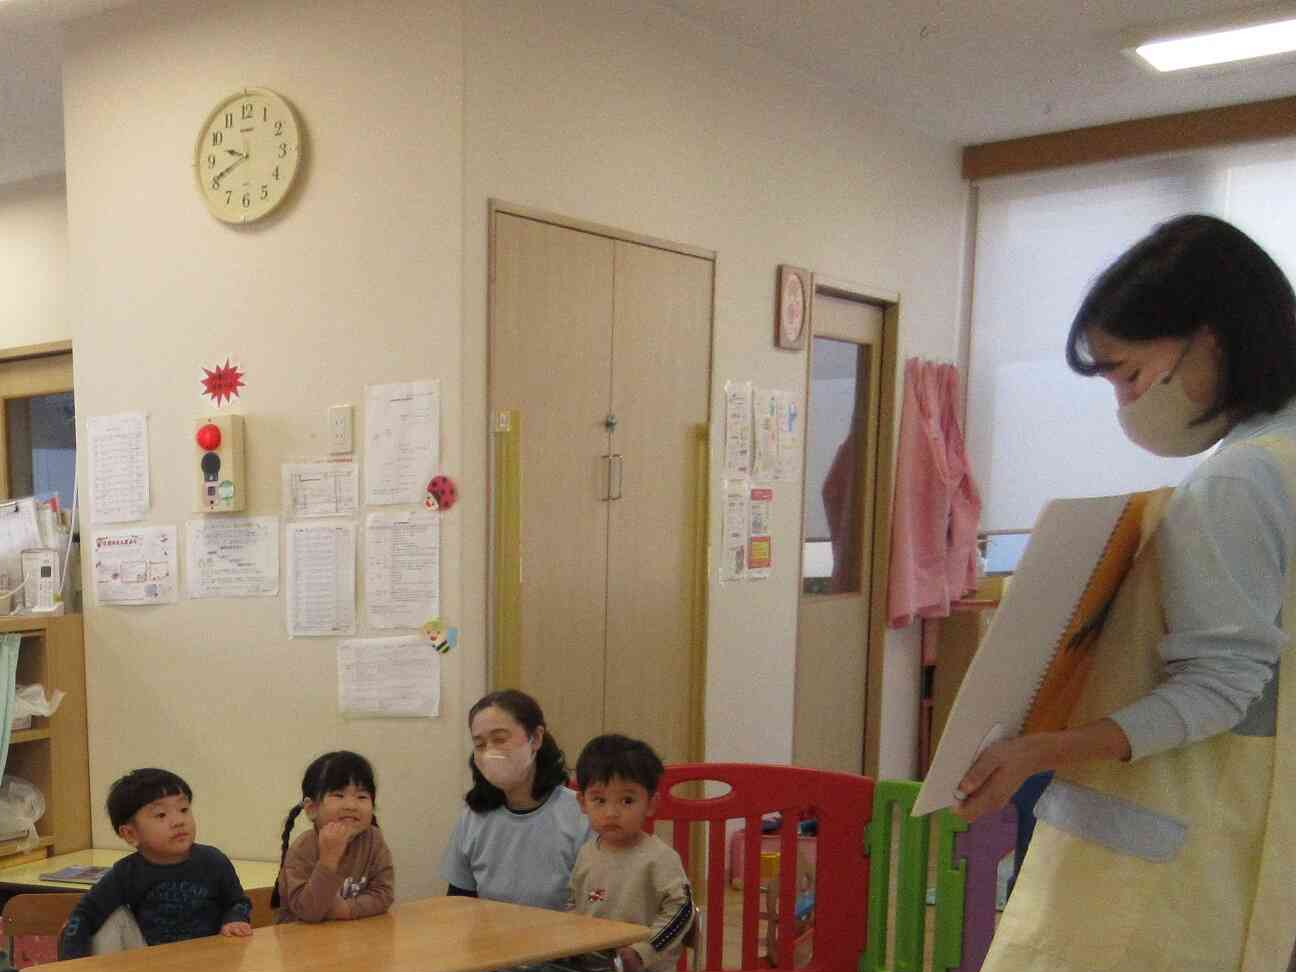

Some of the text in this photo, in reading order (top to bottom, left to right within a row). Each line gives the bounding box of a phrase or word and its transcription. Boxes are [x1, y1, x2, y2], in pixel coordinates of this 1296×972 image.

[241, 103, 253, 119] 12
[262, 105, 268, 122] 1
[225, 113, 233, 128] 11
[274, 120, 282, 136] 2
[212, 130, 223, 146] 10
[278, 143, 287, 158] 3
[207, 154, 216, 169] 9
[272, 166, 280, 181] 4
[211, 176, 220, 190] 8
[225, 190, 232, 205] 7
[260, 185, 269, 200] 5
[242, 193, 250, 208] 6
